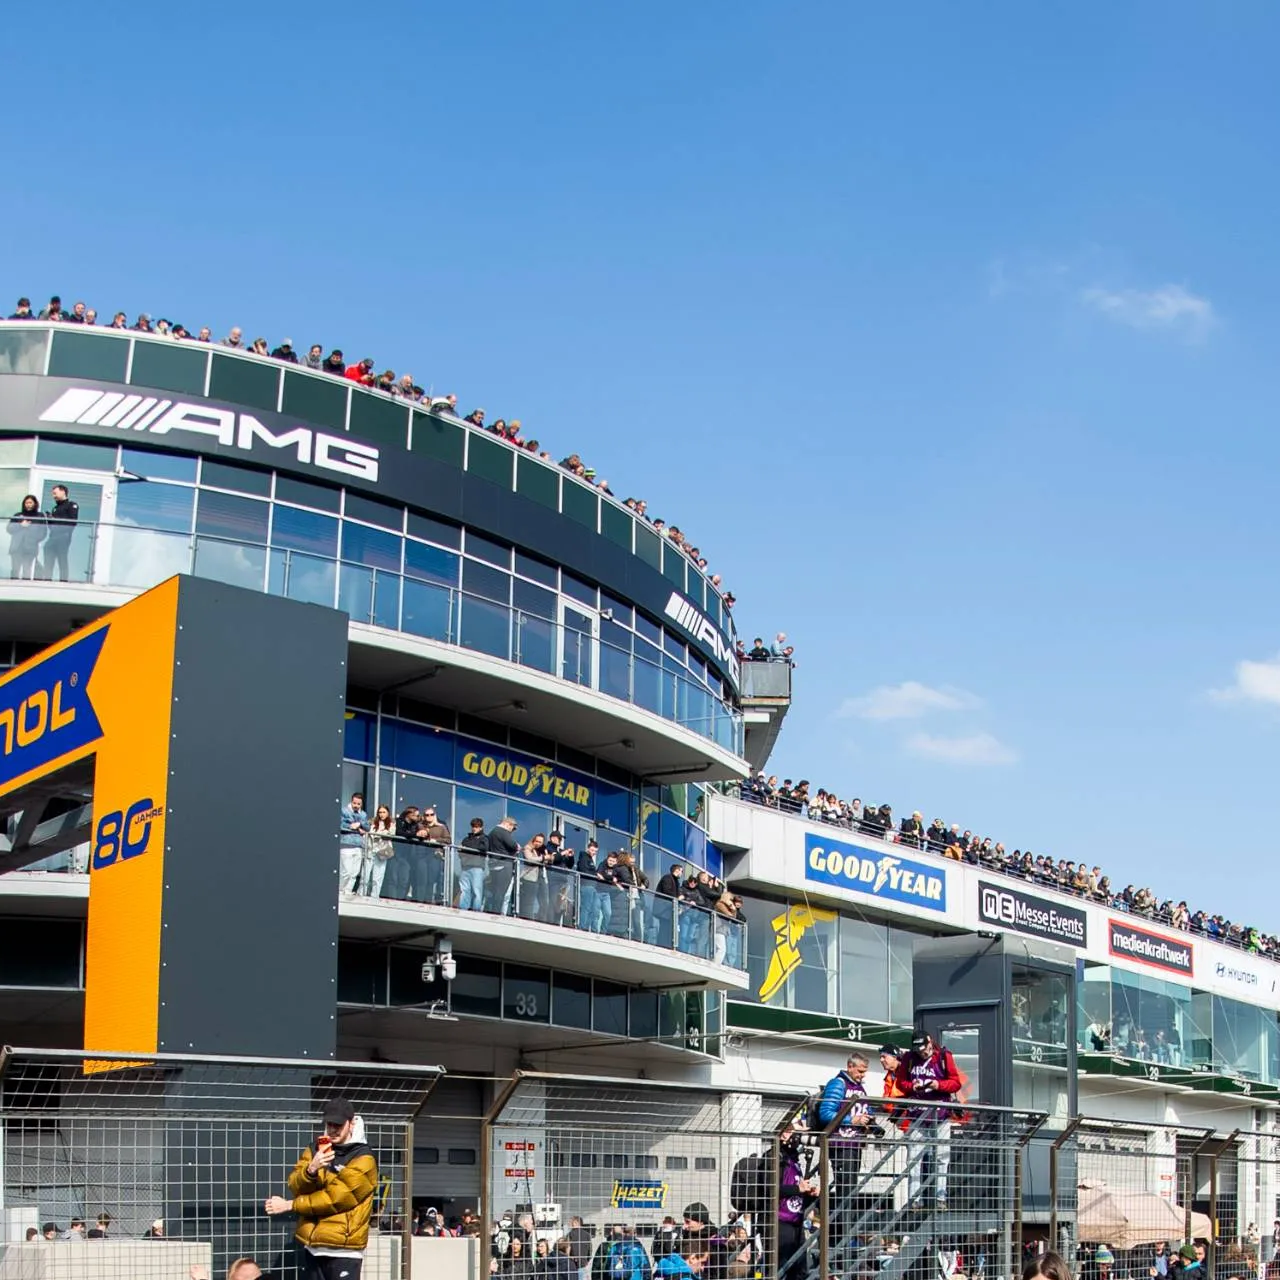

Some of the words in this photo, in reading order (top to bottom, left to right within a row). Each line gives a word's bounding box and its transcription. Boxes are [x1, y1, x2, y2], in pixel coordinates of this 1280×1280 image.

[150, 402, 379, 482] AMG
[93, 798, 154, 870] 80
[134, 807, 163, 824] JAHRE
[1016, 900, 1049, 926] Messe
[1050, 910, 1084, 935] Events
[1113, 931, 1190, 968] medienkraftwerk
[1227, 967, 1258, 986] HYUNDAI
[516, 992, 538, 1017] 33
[848, 1022, 862, 1041] 31
[618, 1185, 663, 1199] HAZET
